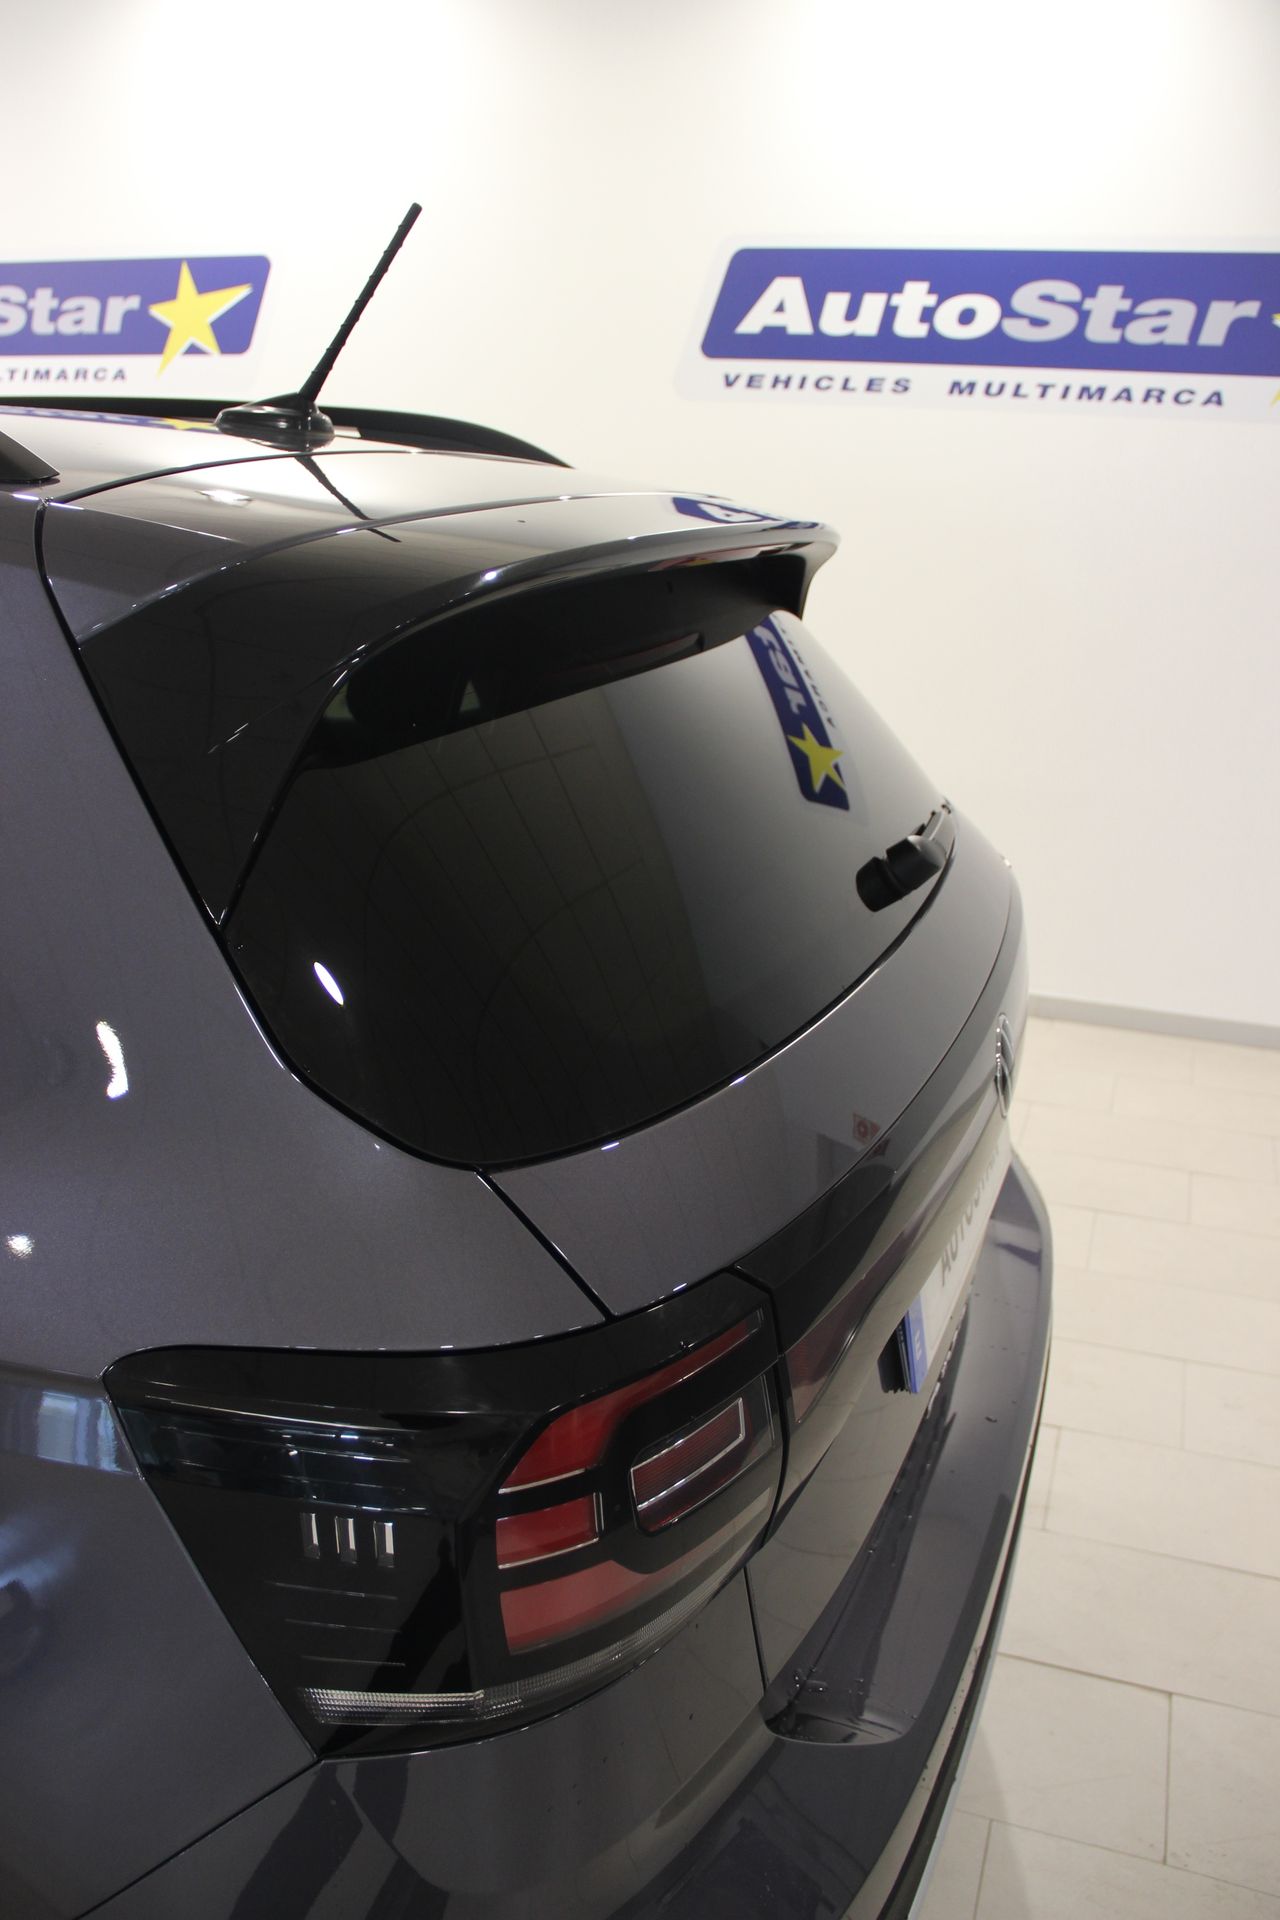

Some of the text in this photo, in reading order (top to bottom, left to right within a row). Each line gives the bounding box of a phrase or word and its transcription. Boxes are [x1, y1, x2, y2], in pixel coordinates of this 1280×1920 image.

[734, 275, 1261, 347] AutoStar
[0, 367, 127, 381] TIMARCA
[723, 373, 1226, 408] VEHICLES MULTIMARCA
